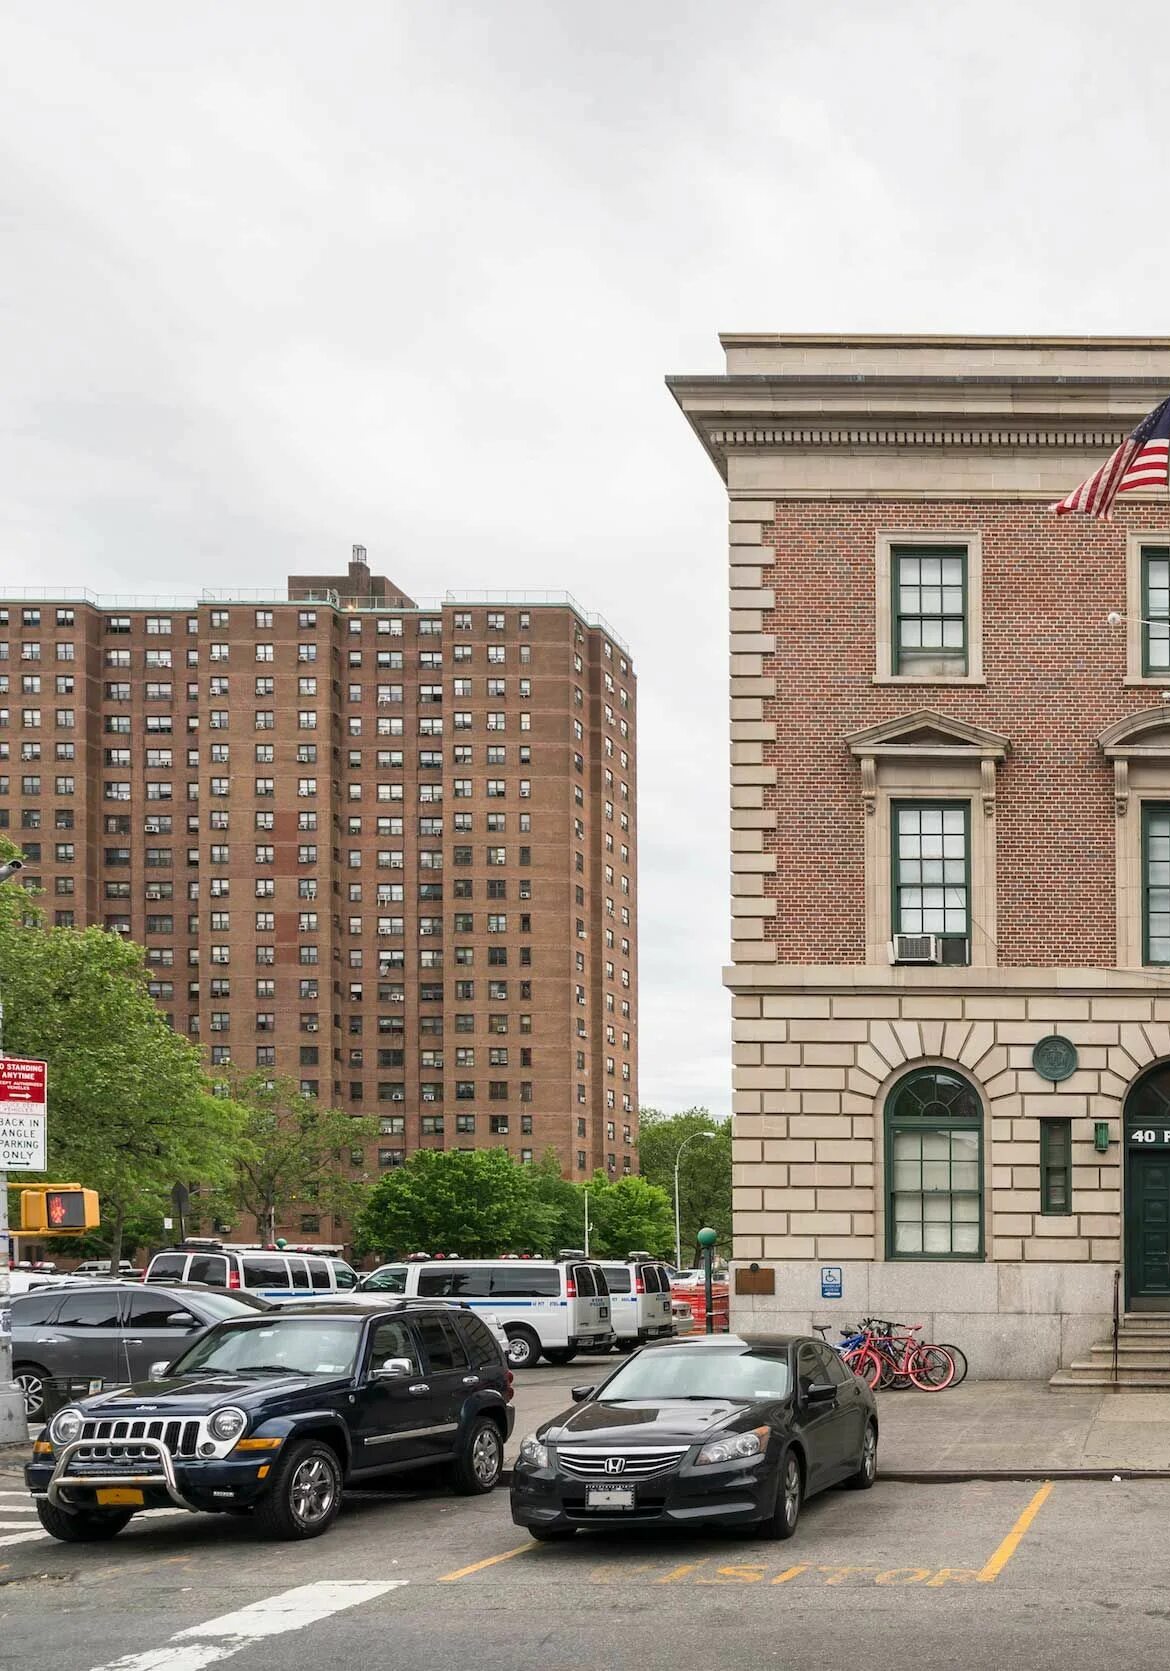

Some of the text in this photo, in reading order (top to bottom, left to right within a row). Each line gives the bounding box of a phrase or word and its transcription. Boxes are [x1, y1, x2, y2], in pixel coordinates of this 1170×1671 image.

[6, 1063, 43, 1072] STANDING
[2, 1072, 35, 1080] ANYTIME
[0, 1118, 39, 1127] BACK IN
[1, 1129, 35, 1138] ANGLE
[1131, 1130, 1156, 1143] 40
[0, 1140, 39, 1149] PARKING
[2, 1150, 34, 1160] ONLY
